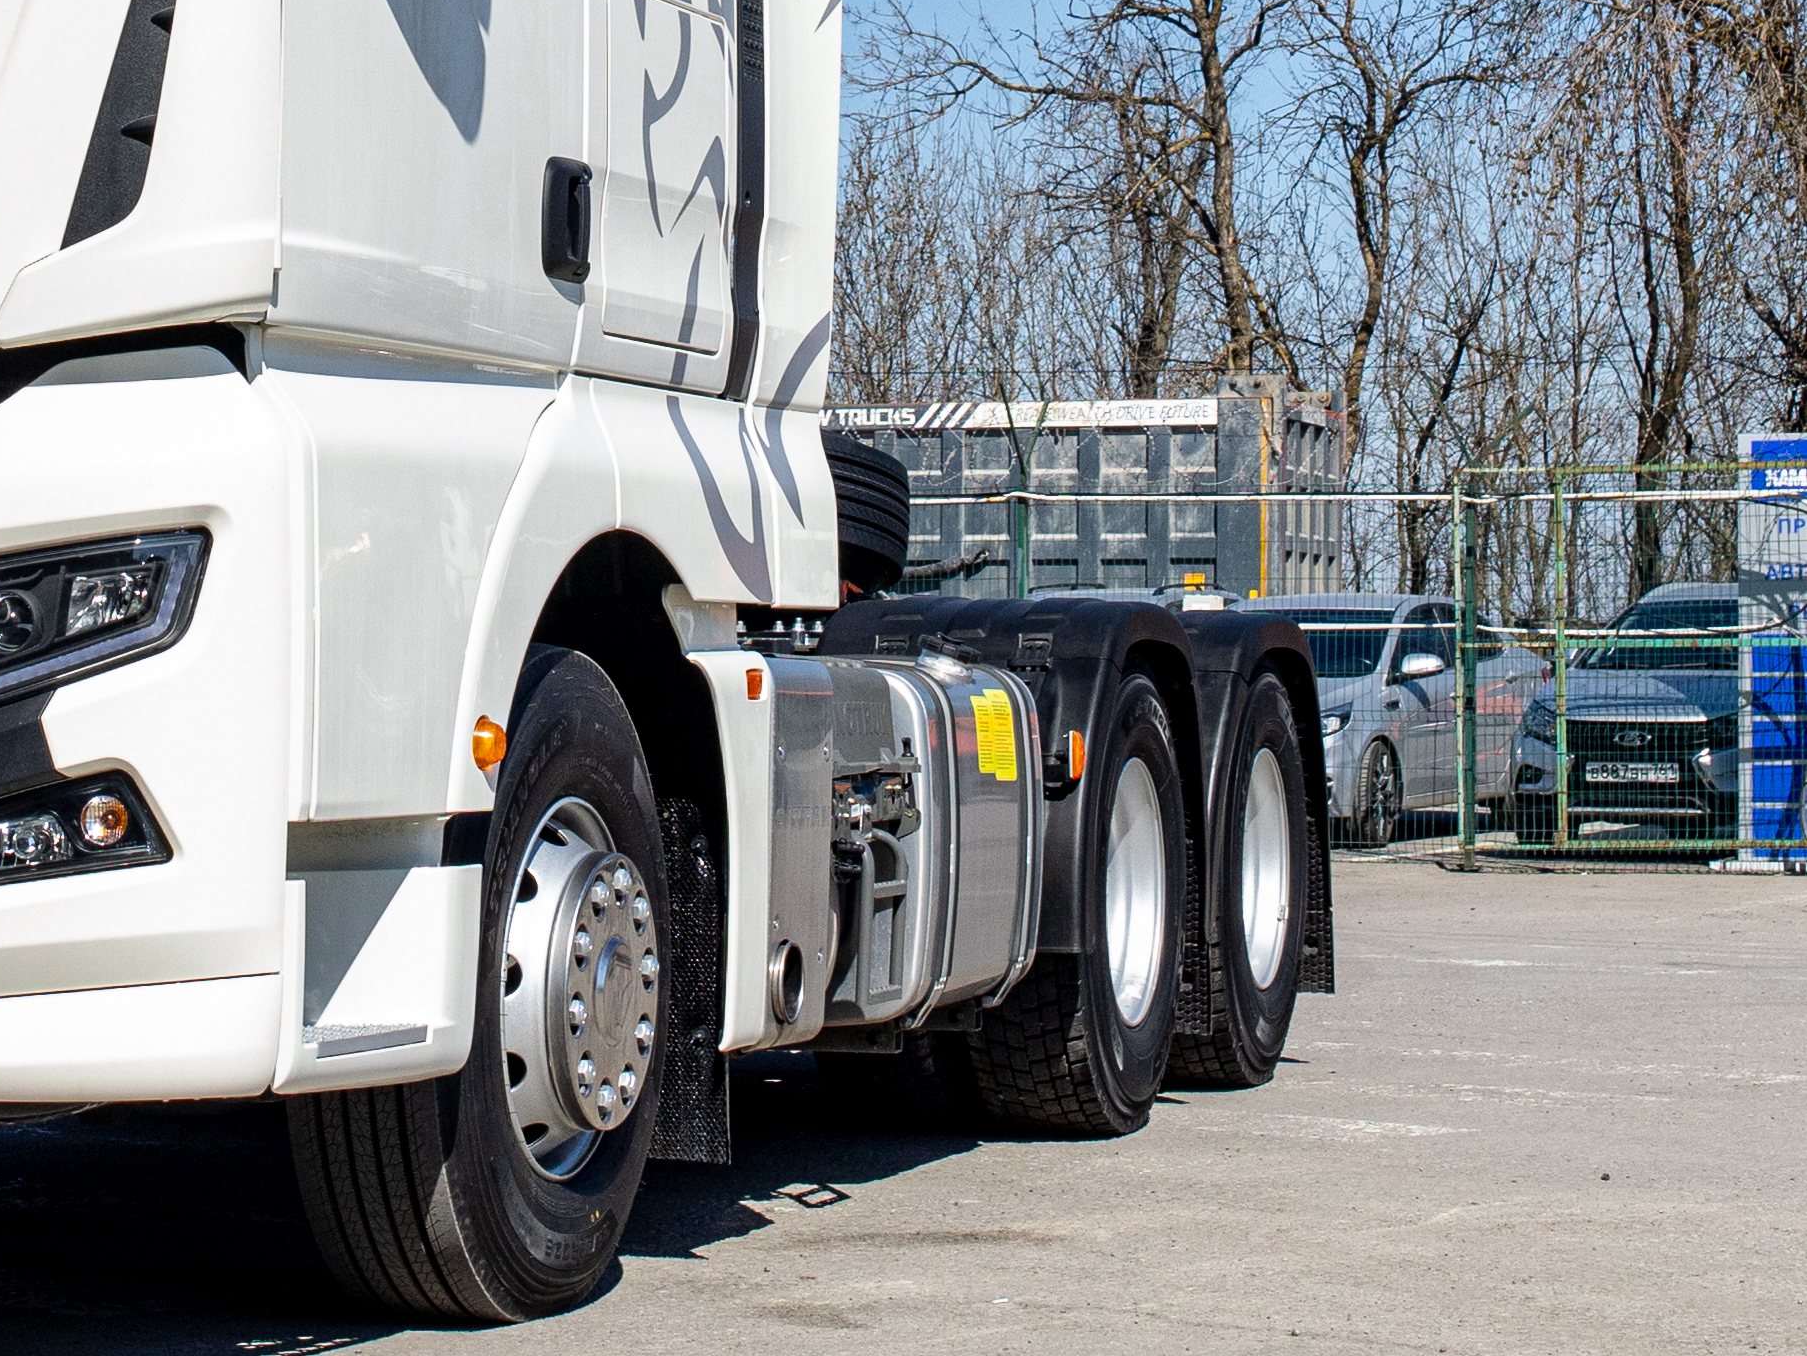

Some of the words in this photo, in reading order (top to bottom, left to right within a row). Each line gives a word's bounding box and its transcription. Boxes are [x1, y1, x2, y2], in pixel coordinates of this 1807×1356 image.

[835, 408, 916, 426] TRUCKS
[1116, 405, 1155, 419] DRIVE
[1160, 404, 1209, 418] FUTURE
